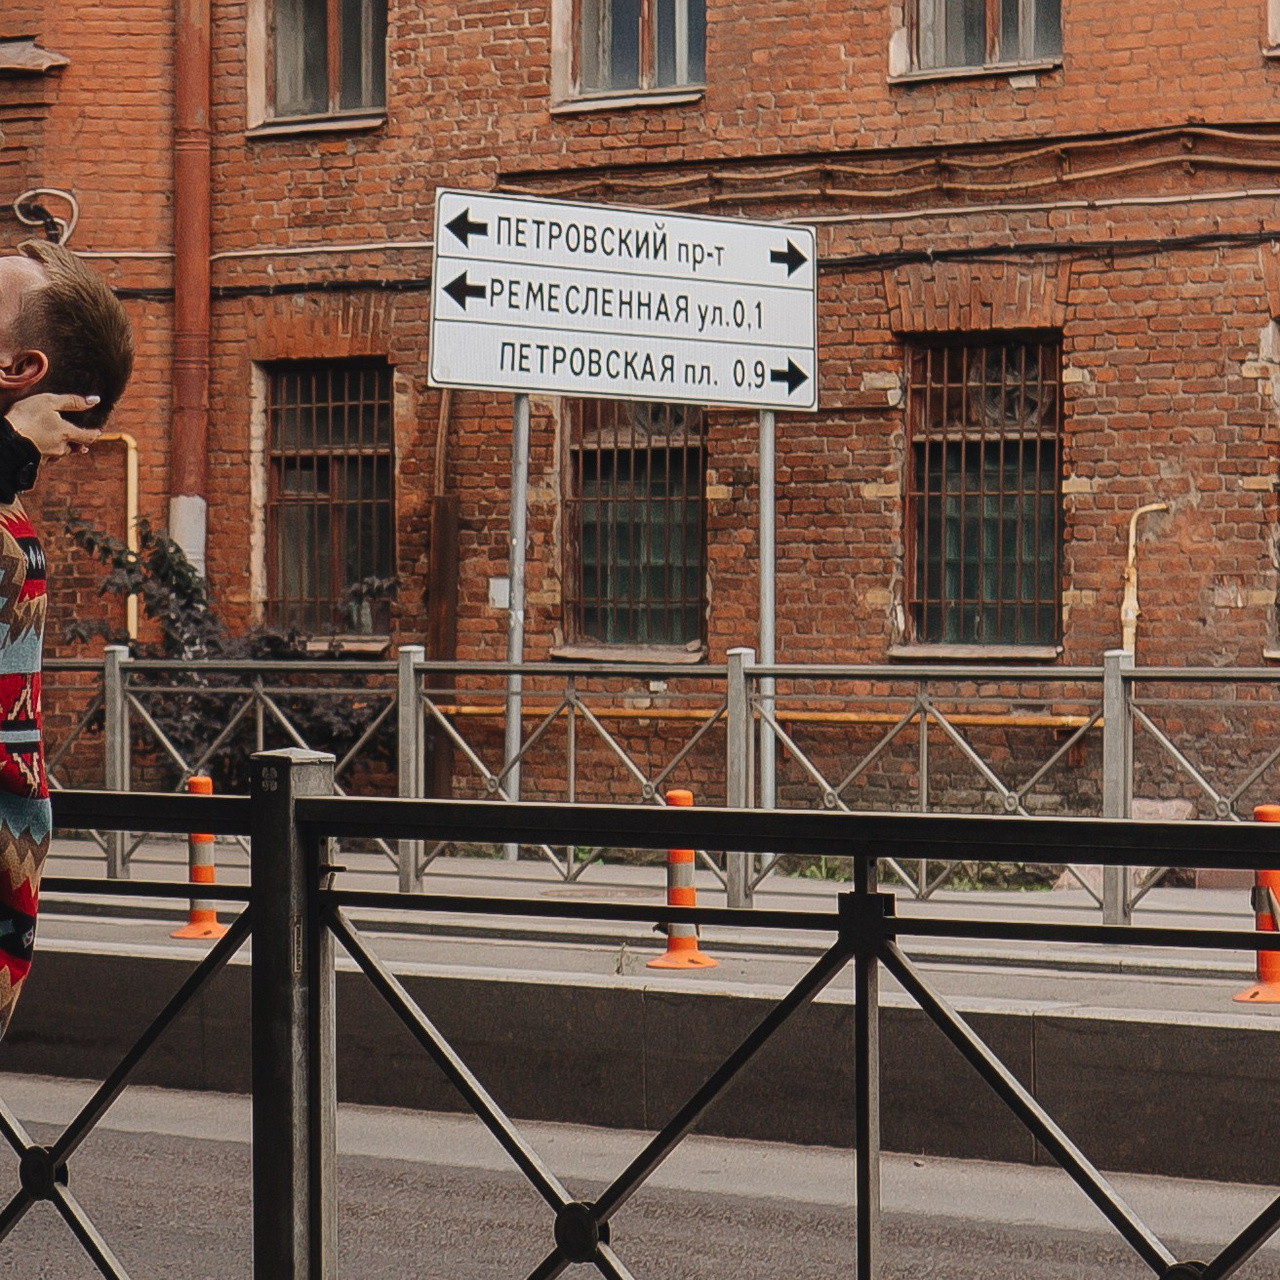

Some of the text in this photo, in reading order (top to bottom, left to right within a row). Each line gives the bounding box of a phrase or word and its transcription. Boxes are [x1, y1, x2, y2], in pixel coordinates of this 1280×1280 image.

[496, 216, 725, 272] ПЕТРОВСКИЙ пр-т
[490, 278, 690, 323] РЕМЕСЛЕННАЯ
[500, 341, 766, 389] ПЕТРОВСКАЯ пл. 0,9
